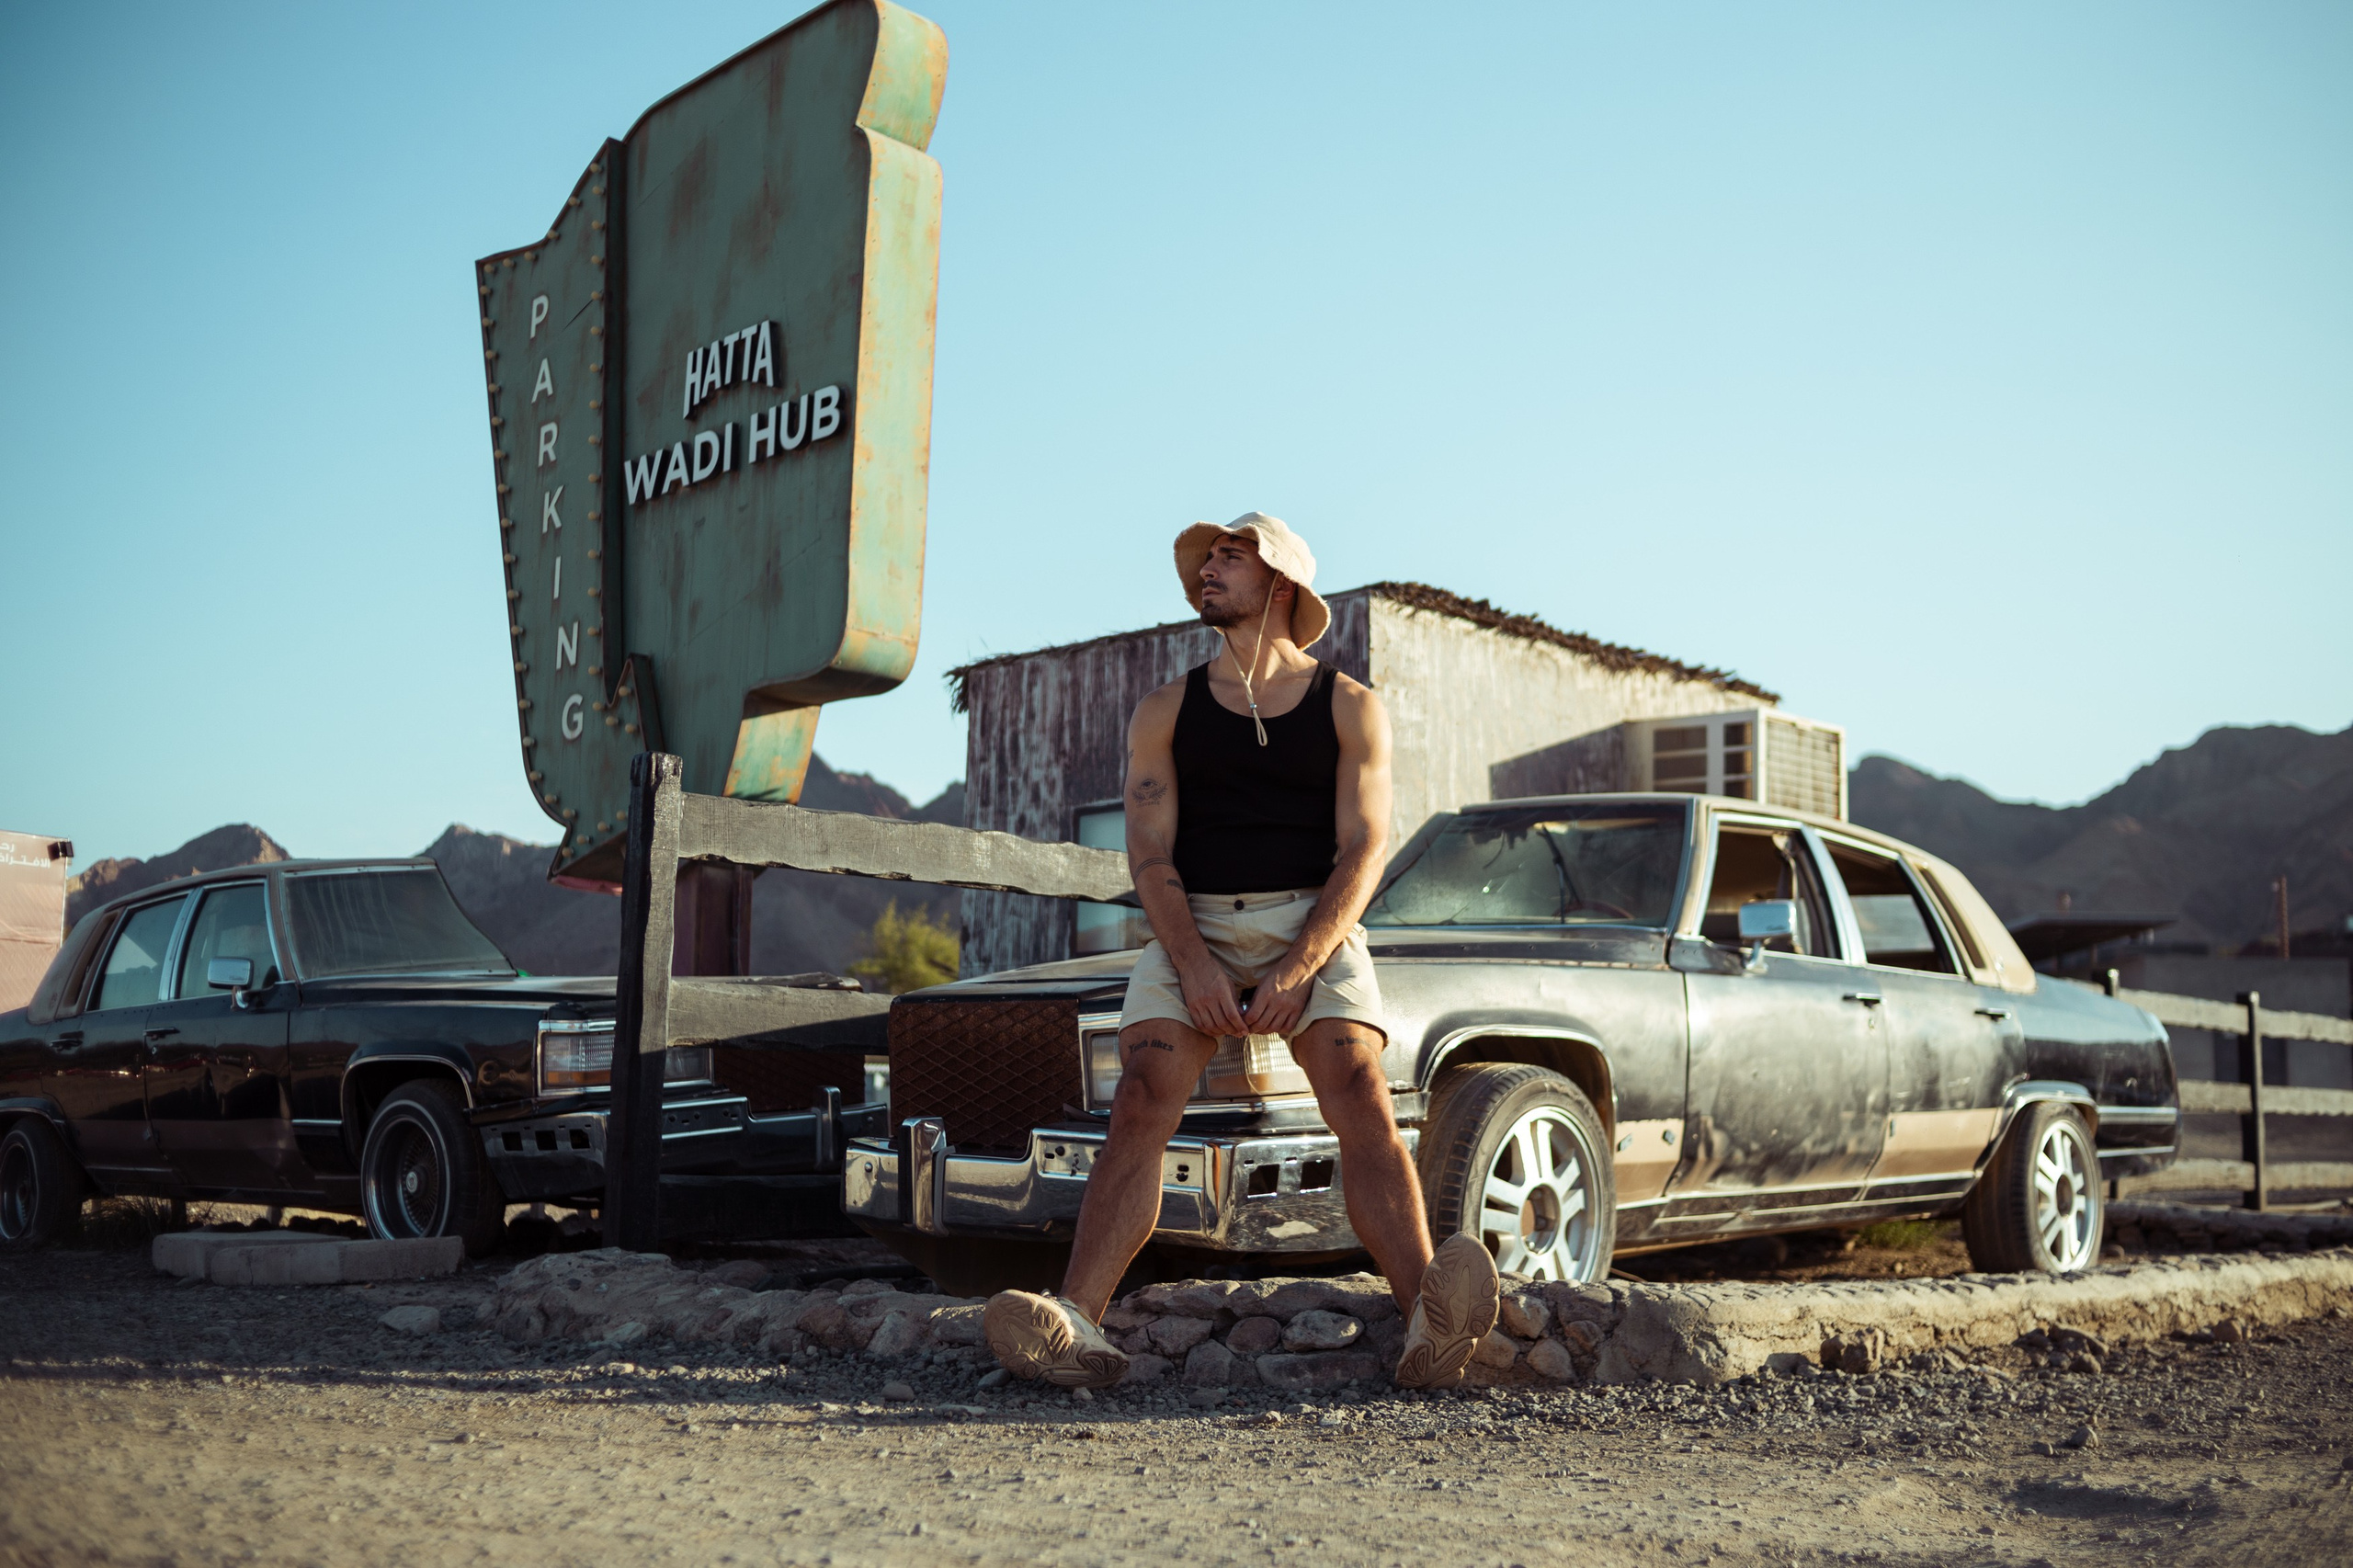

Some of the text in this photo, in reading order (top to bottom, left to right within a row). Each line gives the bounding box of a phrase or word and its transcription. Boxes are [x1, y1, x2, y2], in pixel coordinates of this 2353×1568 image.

[683, 319, 774, 420] HATTA
[624, 384, 841, 506] WADI HUB
[529, 294, 584, 741] PARKING
